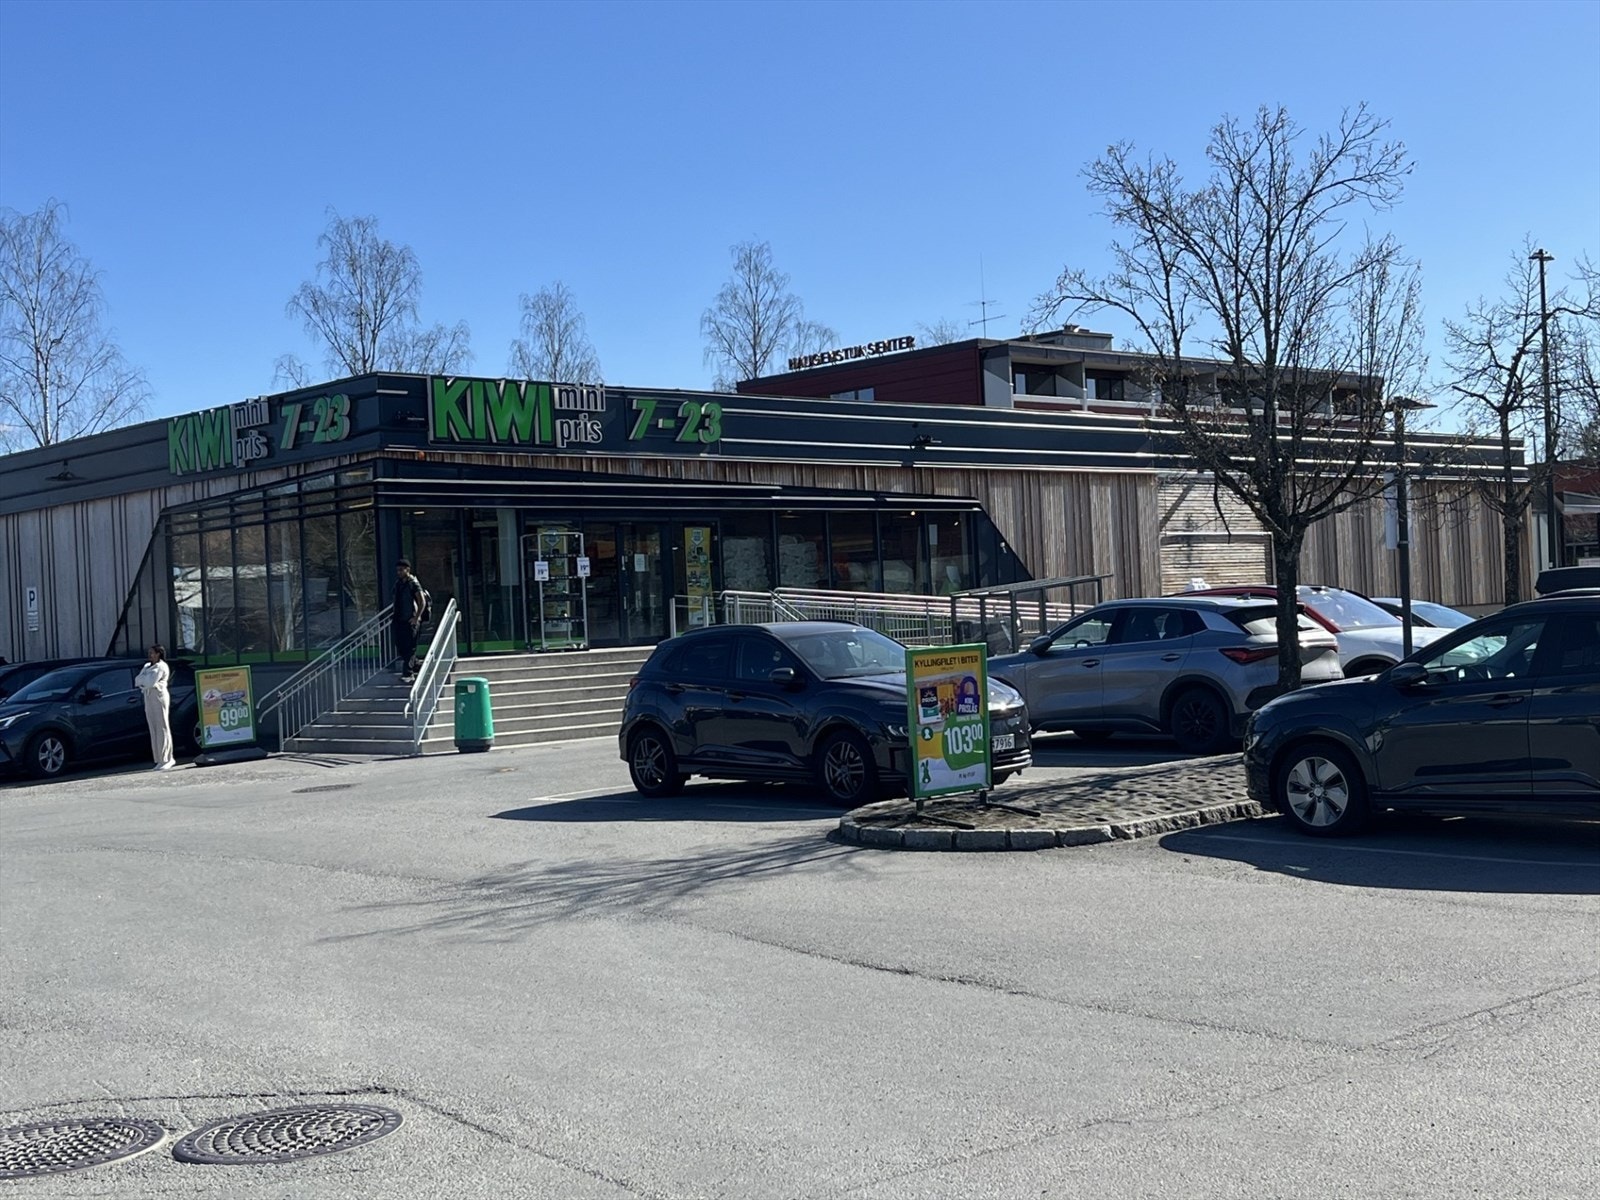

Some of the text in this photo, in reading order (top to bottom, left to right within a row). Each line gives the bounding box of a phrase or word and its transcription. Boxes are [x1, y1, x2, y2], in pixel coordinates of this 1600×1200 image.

[867, 336, 915, 355] SENTER
[234, 396, 269, 429] mini
[433, 378, 551, 444] KIWI
[554, 383, 606, 411] mini
[280, 393, 350, 449] 7-23
[555, 413, 602, 448] pris
[167, 405, 233, 476] KIWI
[234, 430, 268, 468] pris
[29, 590, 35, 608] P
[914, 656, 957, 668] KYLLINGFILET
[961, 655, 979, 665] BITER
